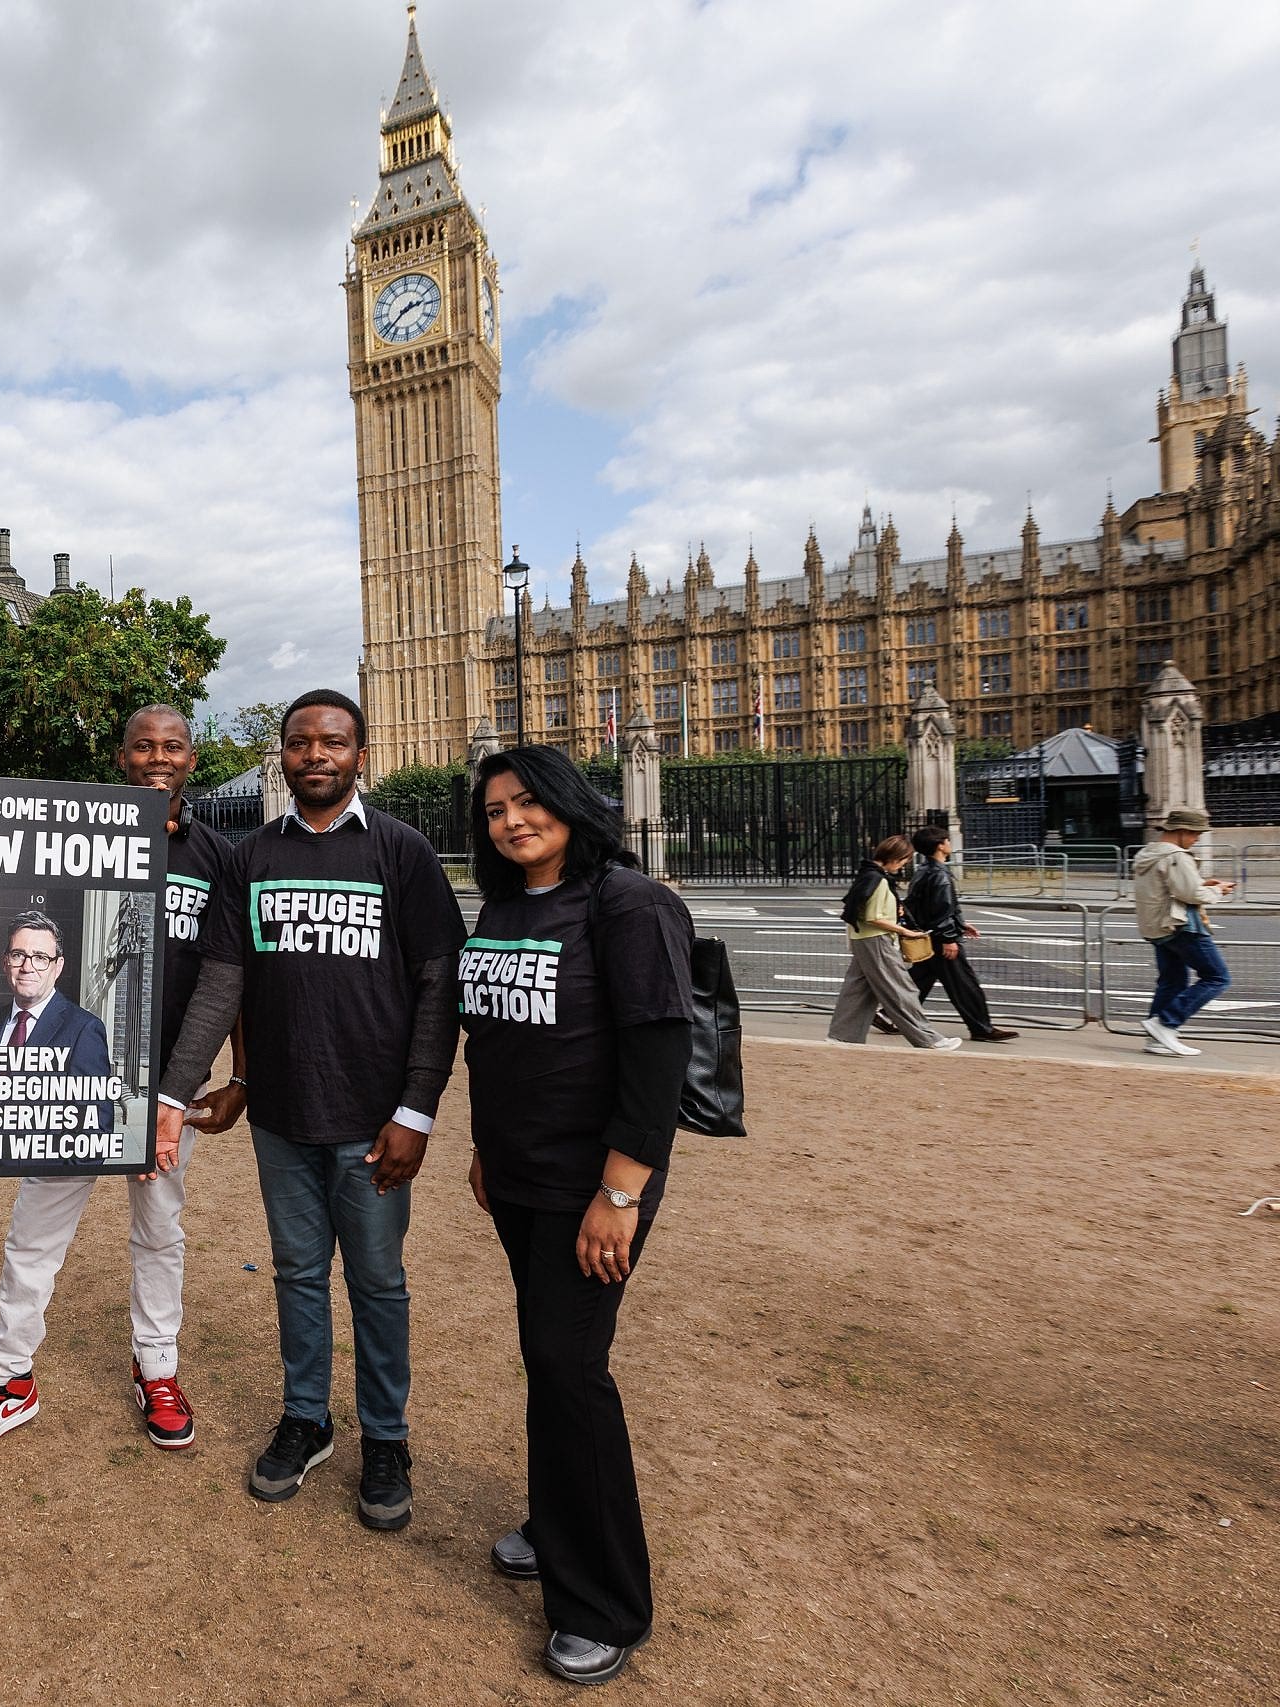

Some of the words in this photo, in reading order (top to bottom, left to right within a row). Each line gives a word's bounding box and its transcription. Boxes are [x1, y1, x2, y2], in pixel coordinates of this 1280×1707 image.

[52, 799, 80, 823] TO
[84, 801, 140, 827] YOUR
[34, 831, 151, 880] HOME
[30, 894, 45, 904] 10
[165, 885, 209, 916] GEE
[260, 892, 382, 928] REFUGEE
[278, 922, 381, 959] ACTION
[458, 951, 560, 990] REFUGEE
[463, 982, 557, 1025] ACTION
[83, 1104, 99, 1130] A
[9, 1133, 123, 1160] WELCOME
